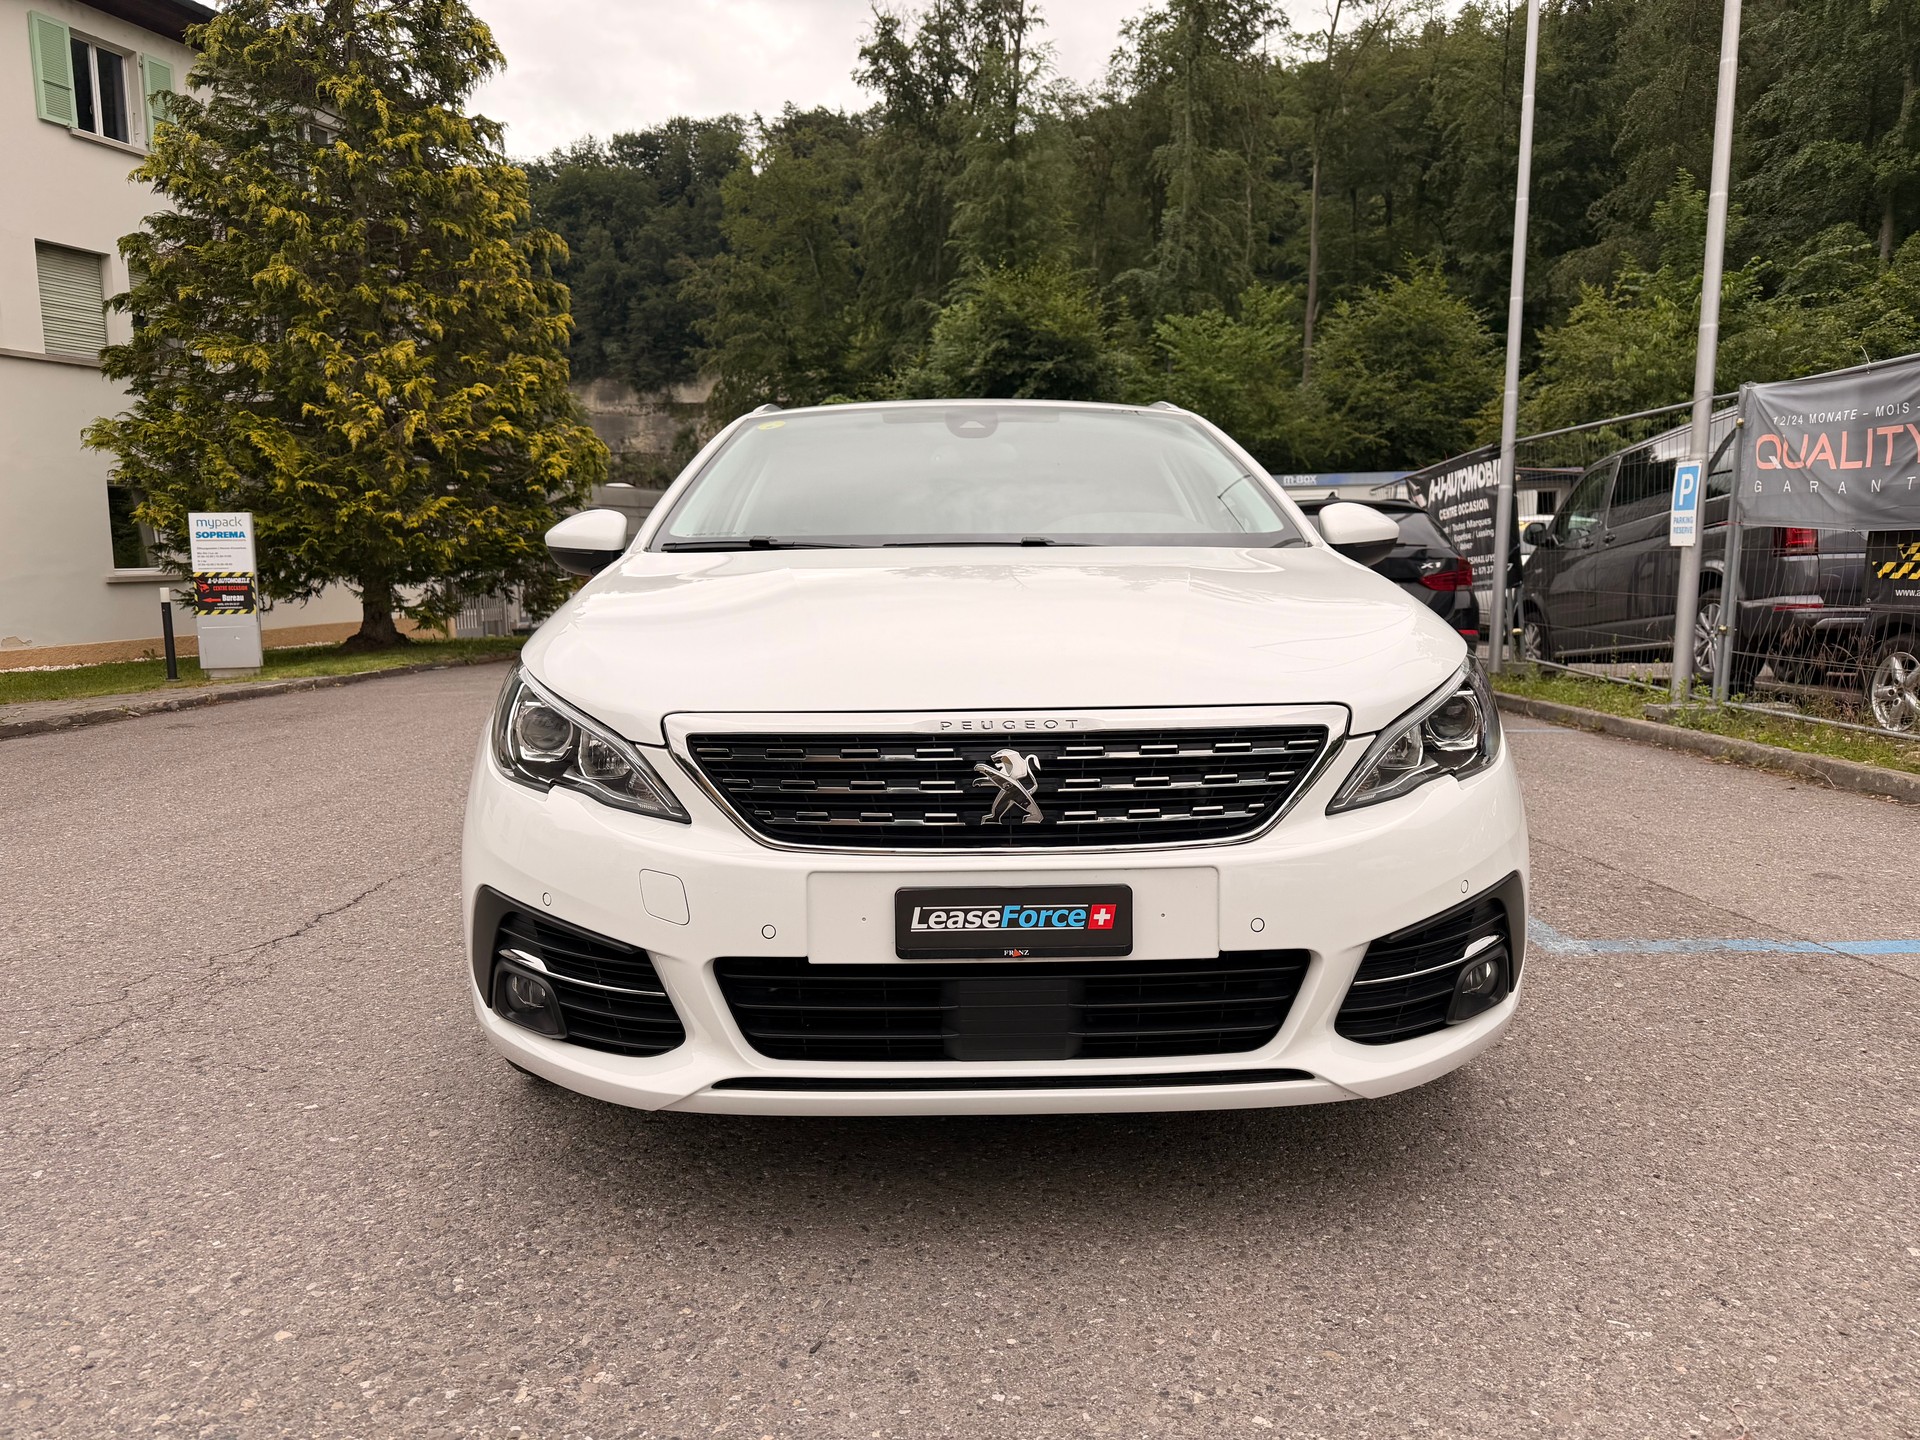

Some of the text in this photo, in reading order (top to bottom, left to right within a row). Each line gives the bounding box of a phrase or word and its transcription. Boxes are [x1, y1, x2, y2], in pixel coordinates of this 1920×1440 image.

[1774, 414, 1803, 426] 12/24
[1809, 409, 1858, 424] MONATE
[1875, 402, 1910, 417] MOIS
[1679, 473, 1694, 506] P
[1458, 498, 1489, 514] OCCASION
[196, 516, 242, 529] mypack
[1466, 517, 1492, 529] Marques
[1673, 516, 1693, 524] PARKING
[195, 531, 246, 539] SOPREMA
[1476, 529, 1494, 539] Leasing
[222, 594, 244, 602] Bureau
[940, 719, 1079, 731] PEUGEOT
[911, 905, 1087, 929] LeaseForce
